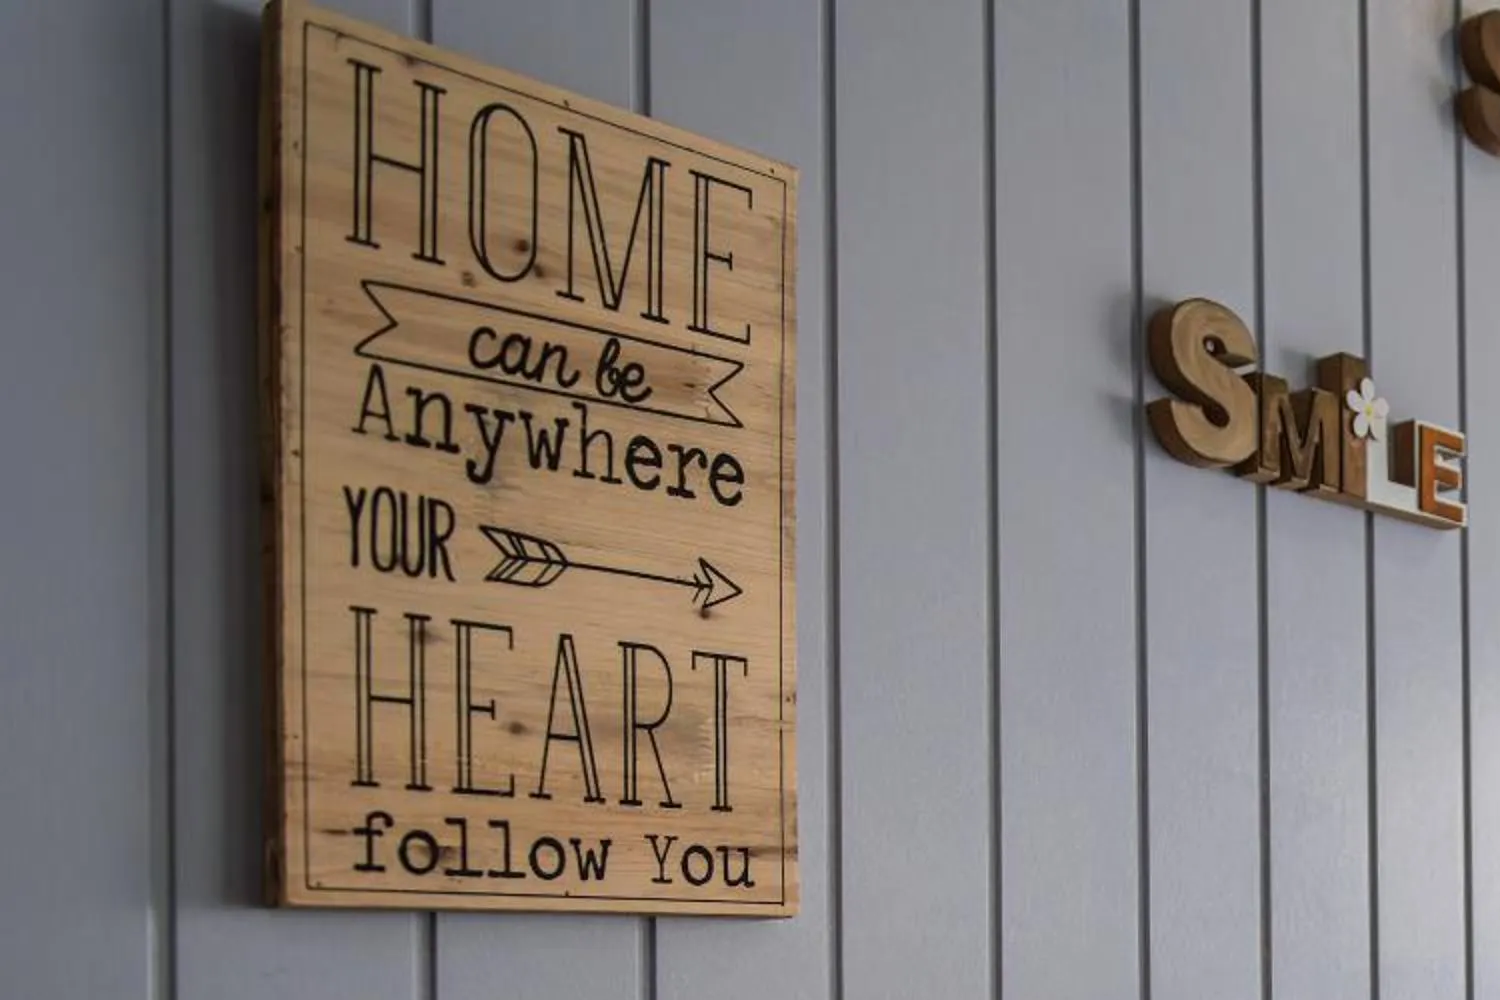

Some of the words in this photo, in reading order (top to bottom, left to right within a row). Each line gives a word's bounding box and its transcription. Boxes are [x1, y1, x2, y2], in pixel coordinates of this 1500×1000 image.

[345, 57, 753, 346] HOME
[468, 326, 580, 389] can
[594, 338, 654, 404] be
[351, 363, 746, 507] Anywhere
[343, 486, 457, 583] YOUR
[348, 604, 749, 813] HEART
[352, 810, 613, 881] follow
[644, 834, 756, 889] You
